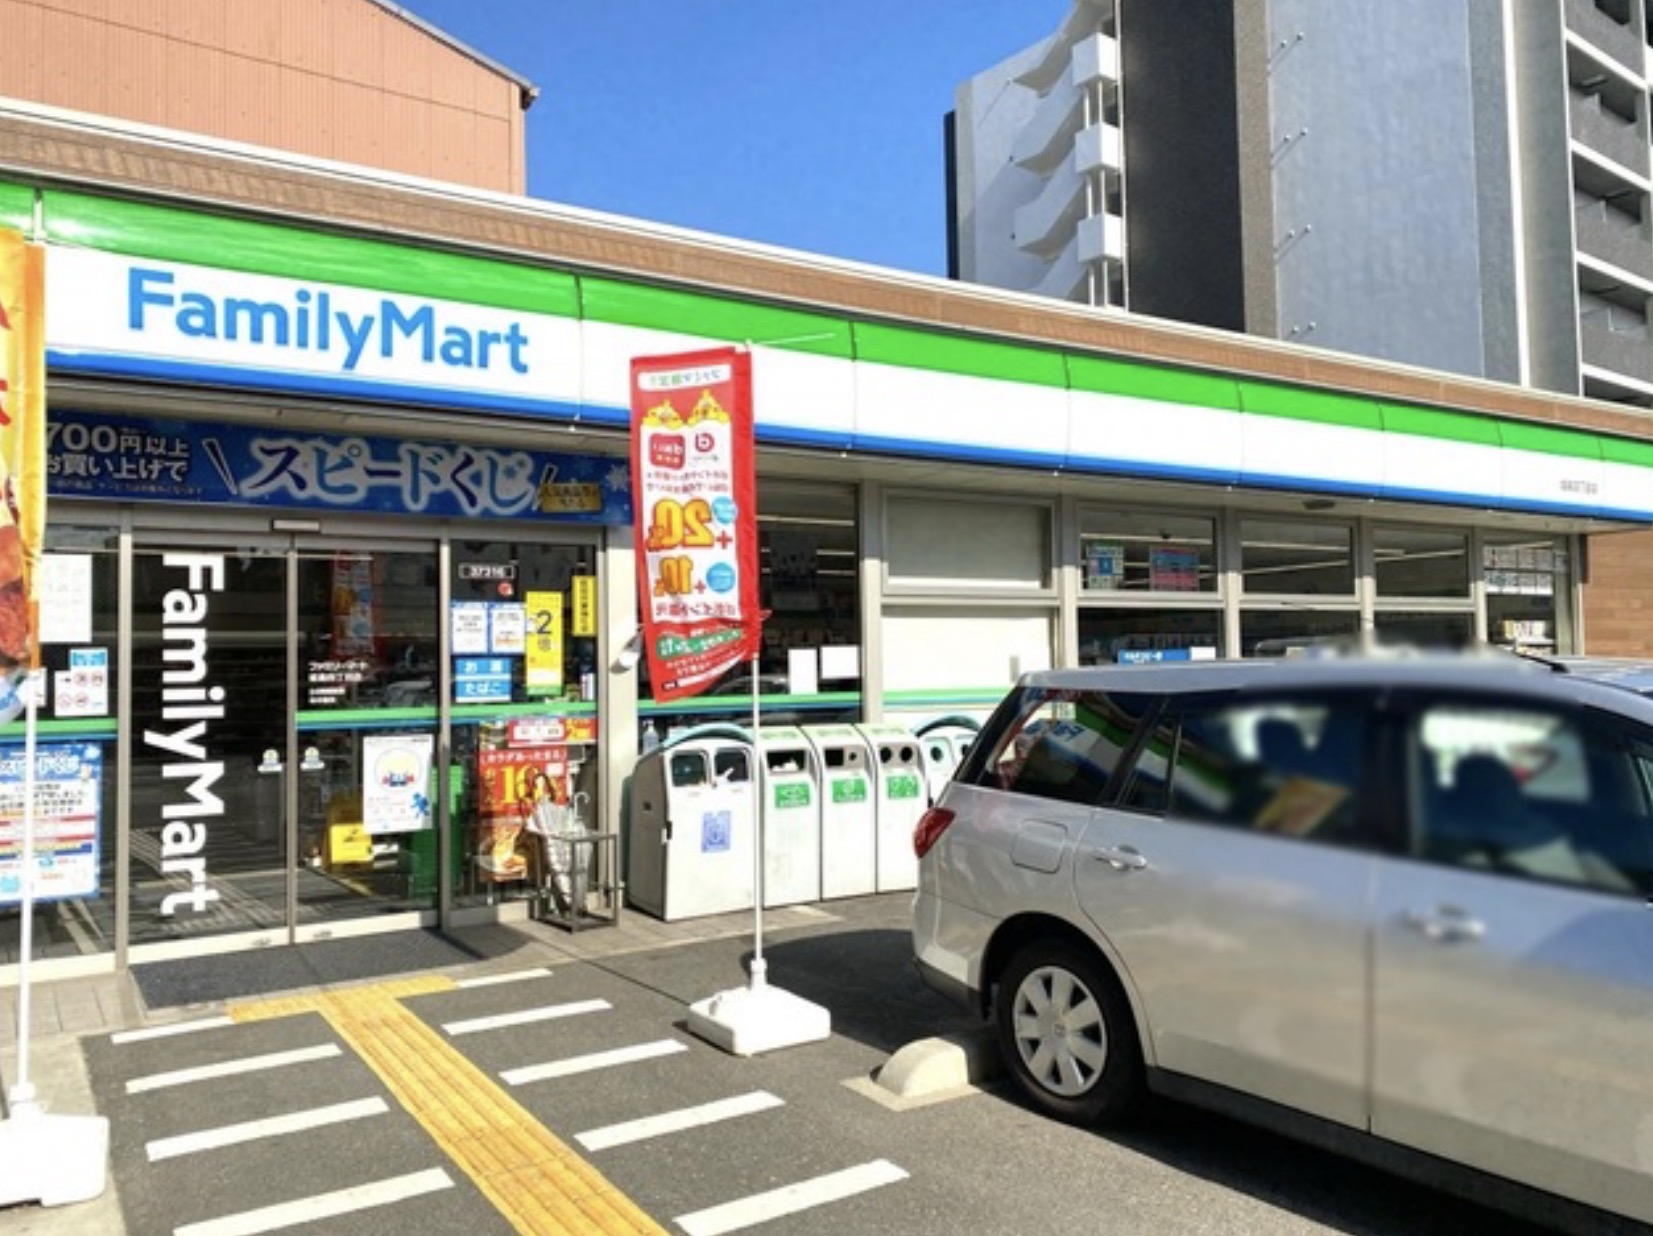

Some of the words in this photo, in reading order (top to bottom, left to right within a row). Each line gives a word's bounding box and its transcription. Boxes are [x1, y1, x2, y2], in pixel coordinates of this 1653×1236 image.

[128, 266, 529, 374] FamilyMart
[242, 437, 533, 515] スピードくじ
[144, 553, 225, 916] FamilyMart
